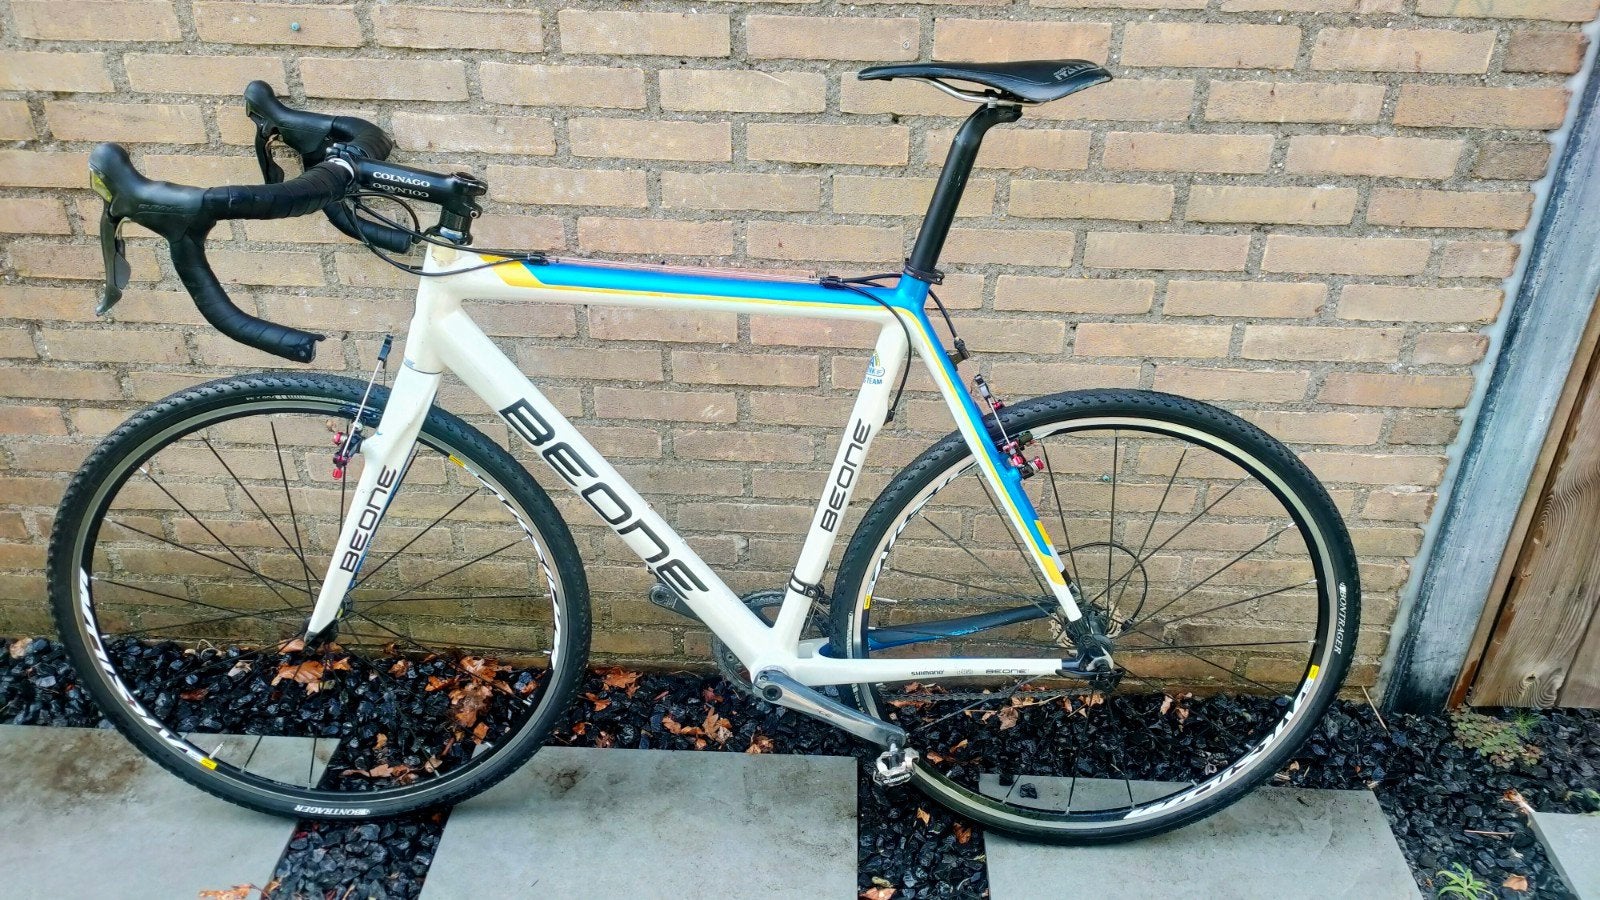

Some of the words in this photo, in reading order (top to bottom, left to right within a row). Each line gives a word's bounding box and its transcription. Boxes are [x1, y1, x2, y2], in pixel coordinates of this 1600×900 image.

[372, 171, 430, 188] COLNAGO
[372, 182, 429, 198] COLNAGO
[498, 397, 709, 601] BEONE
[819, 418, 871, 532] BEONE
[339, 464, 397, 572] BEONE
[1334, 591, 1347, 655] BONTRAGER
[294, 804, 364, 816] BONTRAGER
